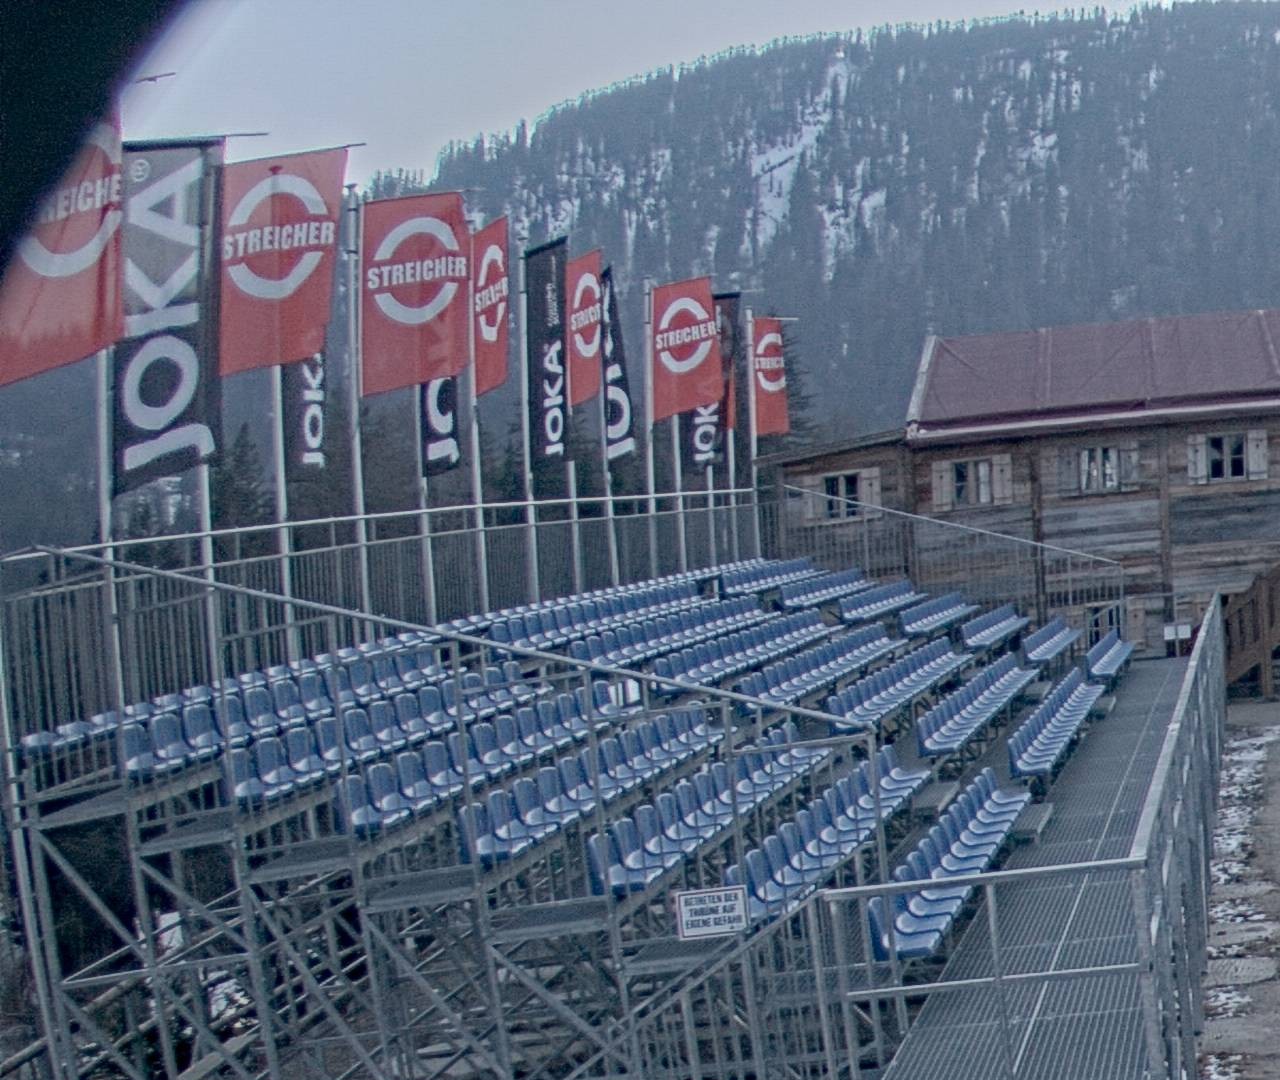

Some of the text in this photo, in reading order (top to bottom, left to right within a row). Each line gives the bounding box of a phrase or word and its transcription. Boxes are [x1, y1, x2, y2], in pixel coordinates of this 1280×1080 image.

[223, 220, 335, 260] STREICHER
[366, 256, 468, 290] STREICHER
[122, 157, 215, 471] JOKA
[655, 320, 717, 350] STREICHER
[302, 353, 325, 468] JOK
[543, 340, 564, 456] JOKA
[693, 401, 719, 462] JOK
